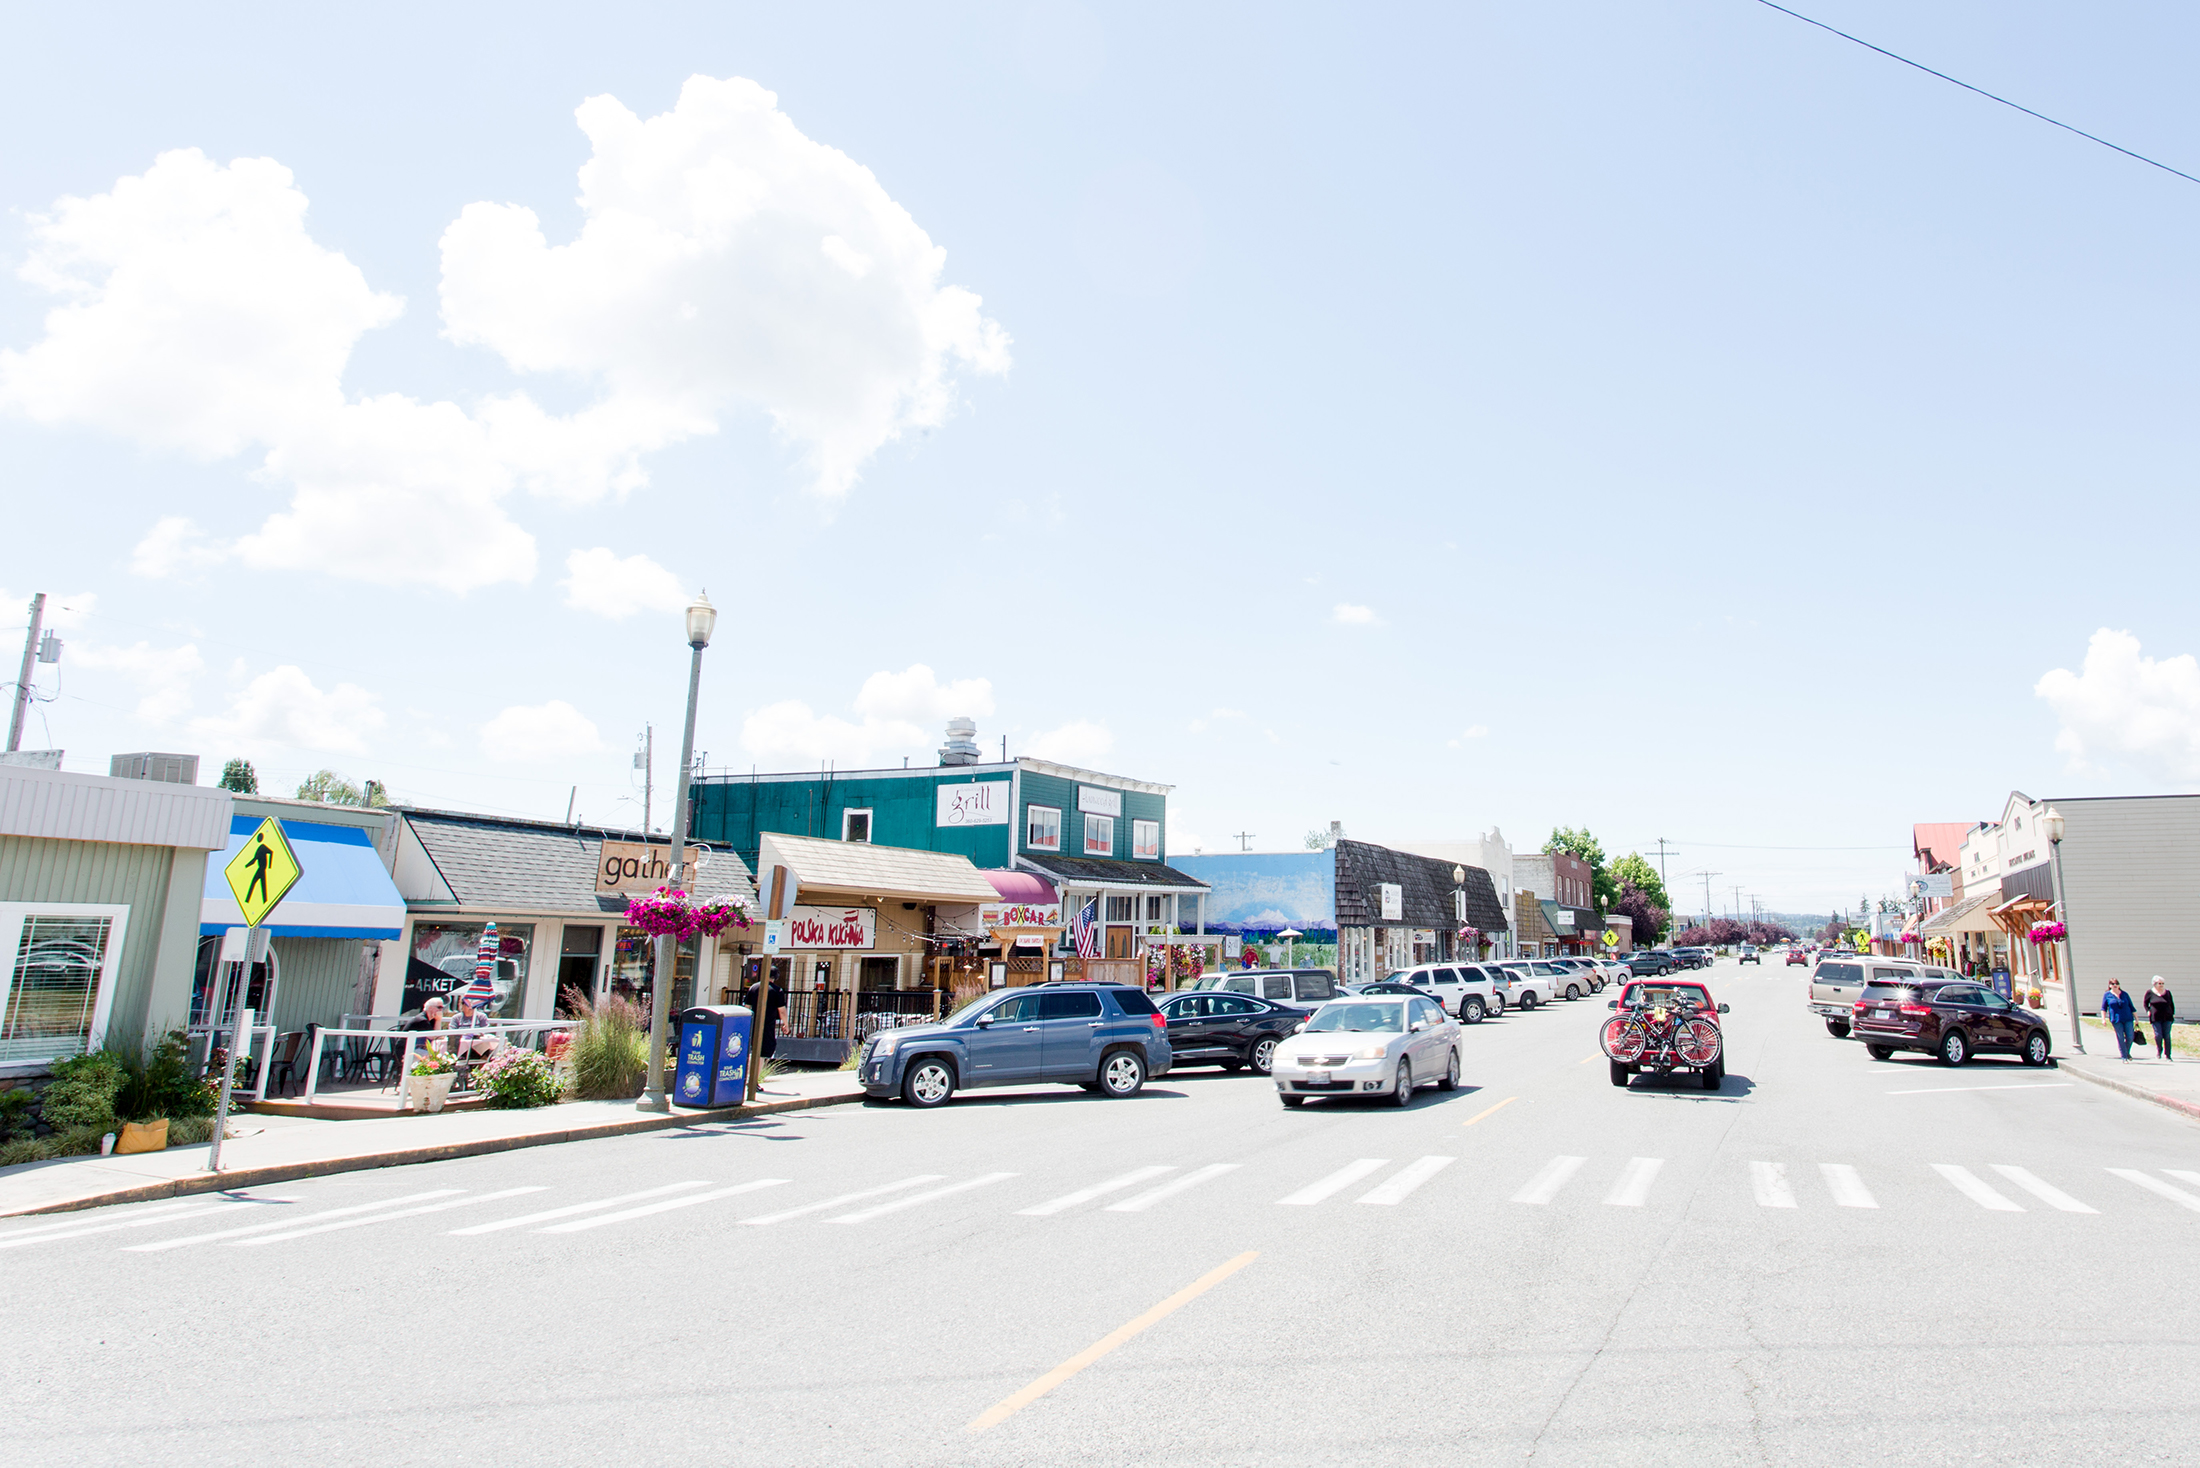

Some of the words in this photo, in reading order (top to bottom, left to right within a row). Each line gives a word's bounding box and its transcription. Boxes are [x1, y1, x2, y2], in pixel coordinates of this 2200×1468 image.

[948, 785, 991, 824] grill
[1003, 905, 1045, 926] BOXCAR
[791, 918, 824, 947] POLSKA
